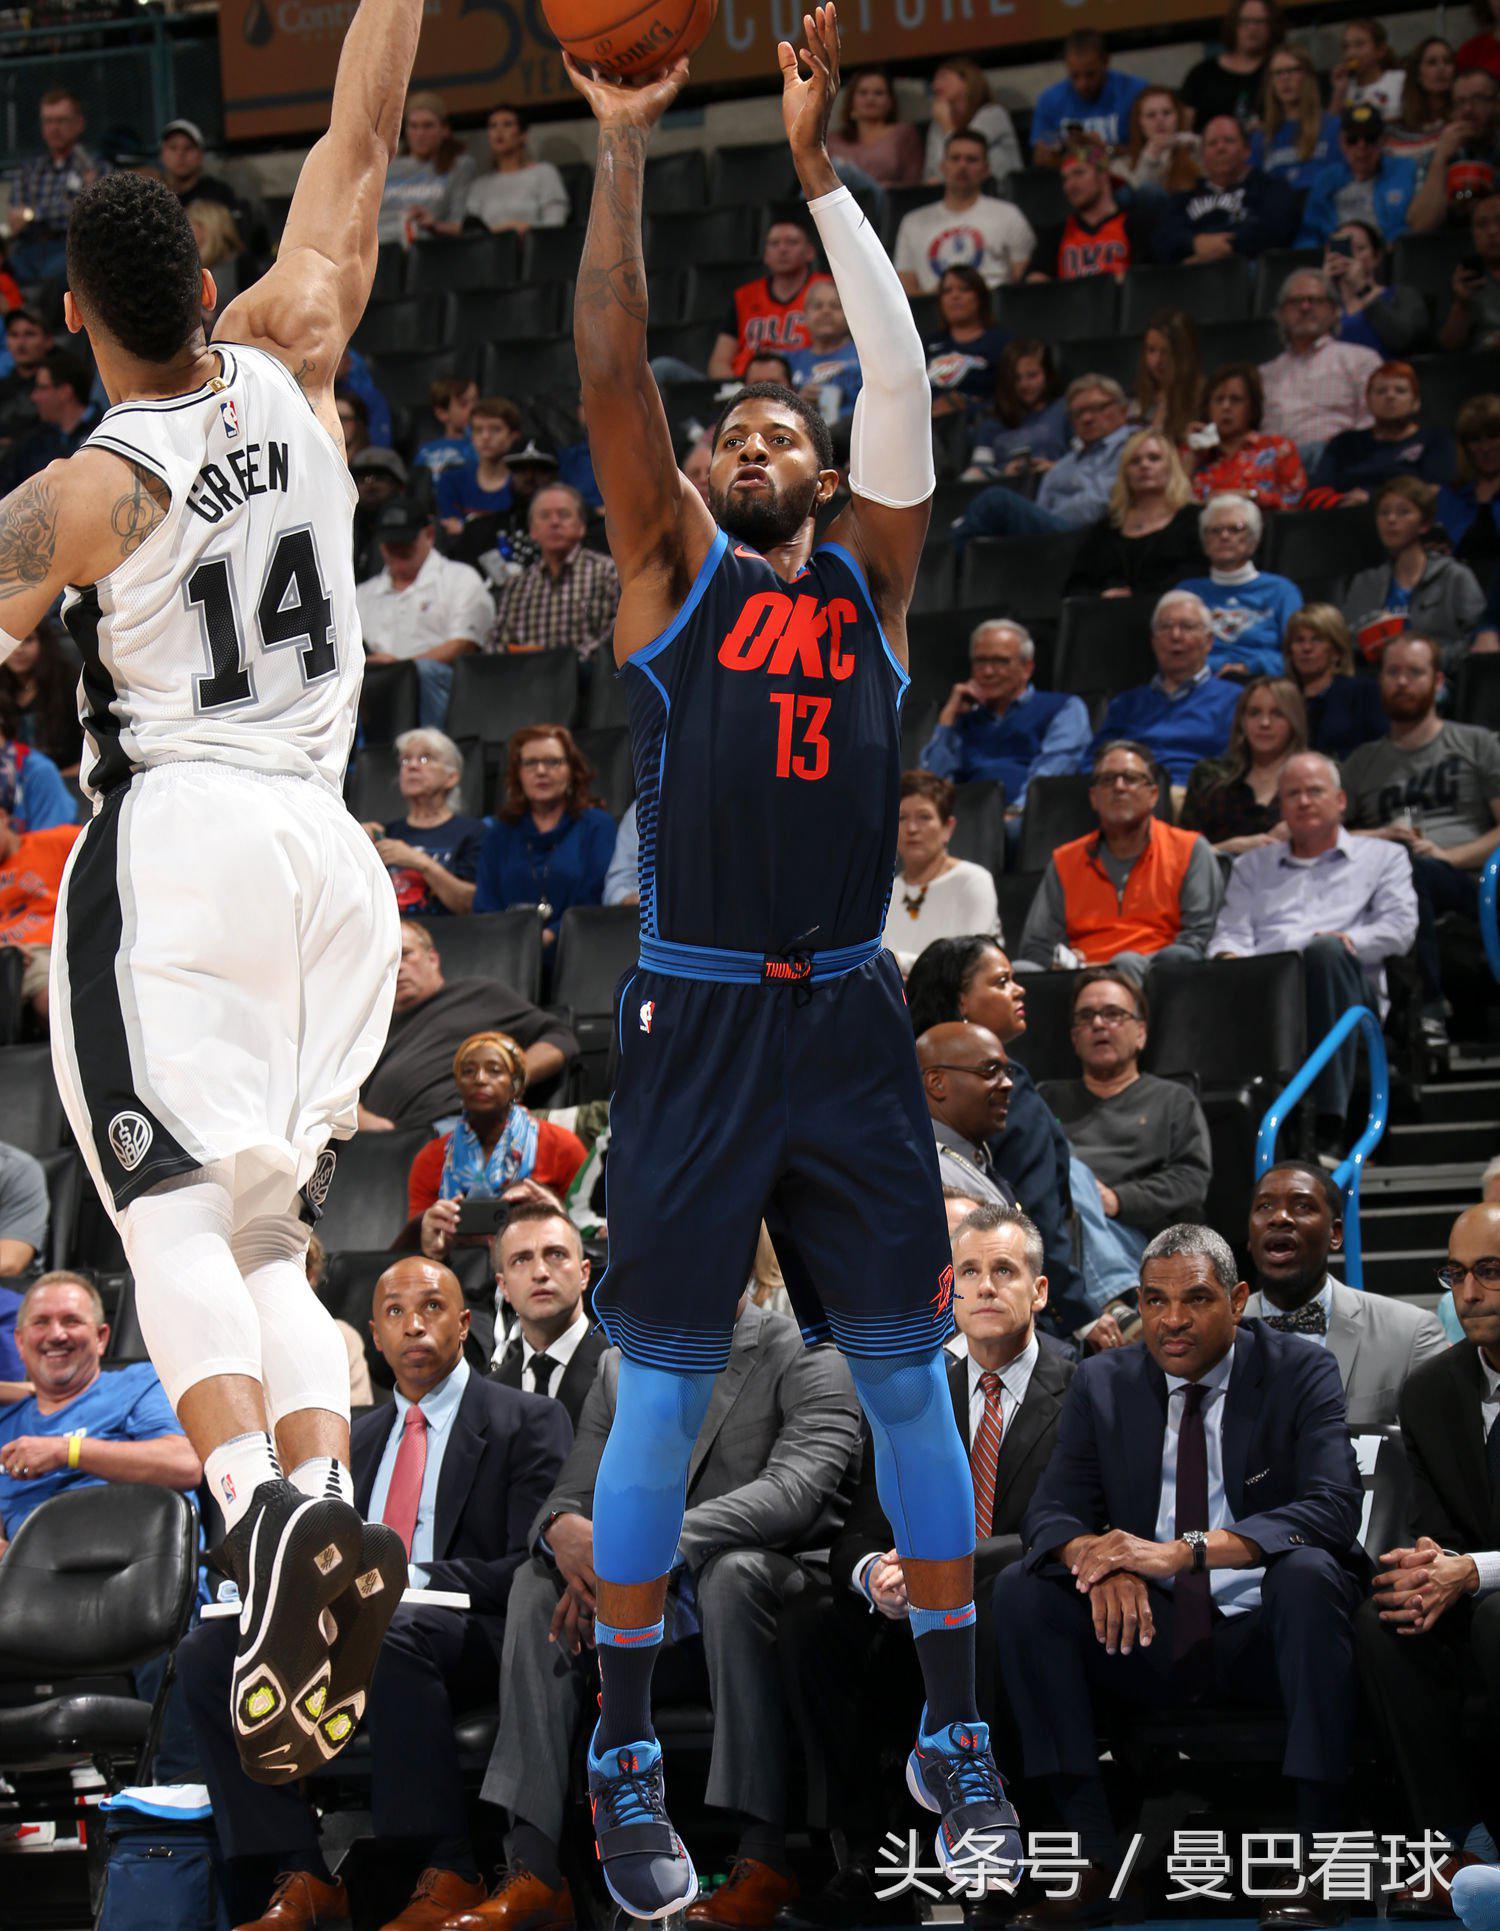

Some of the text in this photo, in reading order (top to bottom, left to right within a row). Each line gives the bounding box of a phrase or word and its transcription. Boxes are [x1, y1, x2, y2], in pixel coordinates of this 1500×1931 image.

[185, 441, 289, 524] GREEN
[181, 520, 341, 716] 14
[717, 591, 858, 681] OKC
[769, 692, 832, 781] 13
